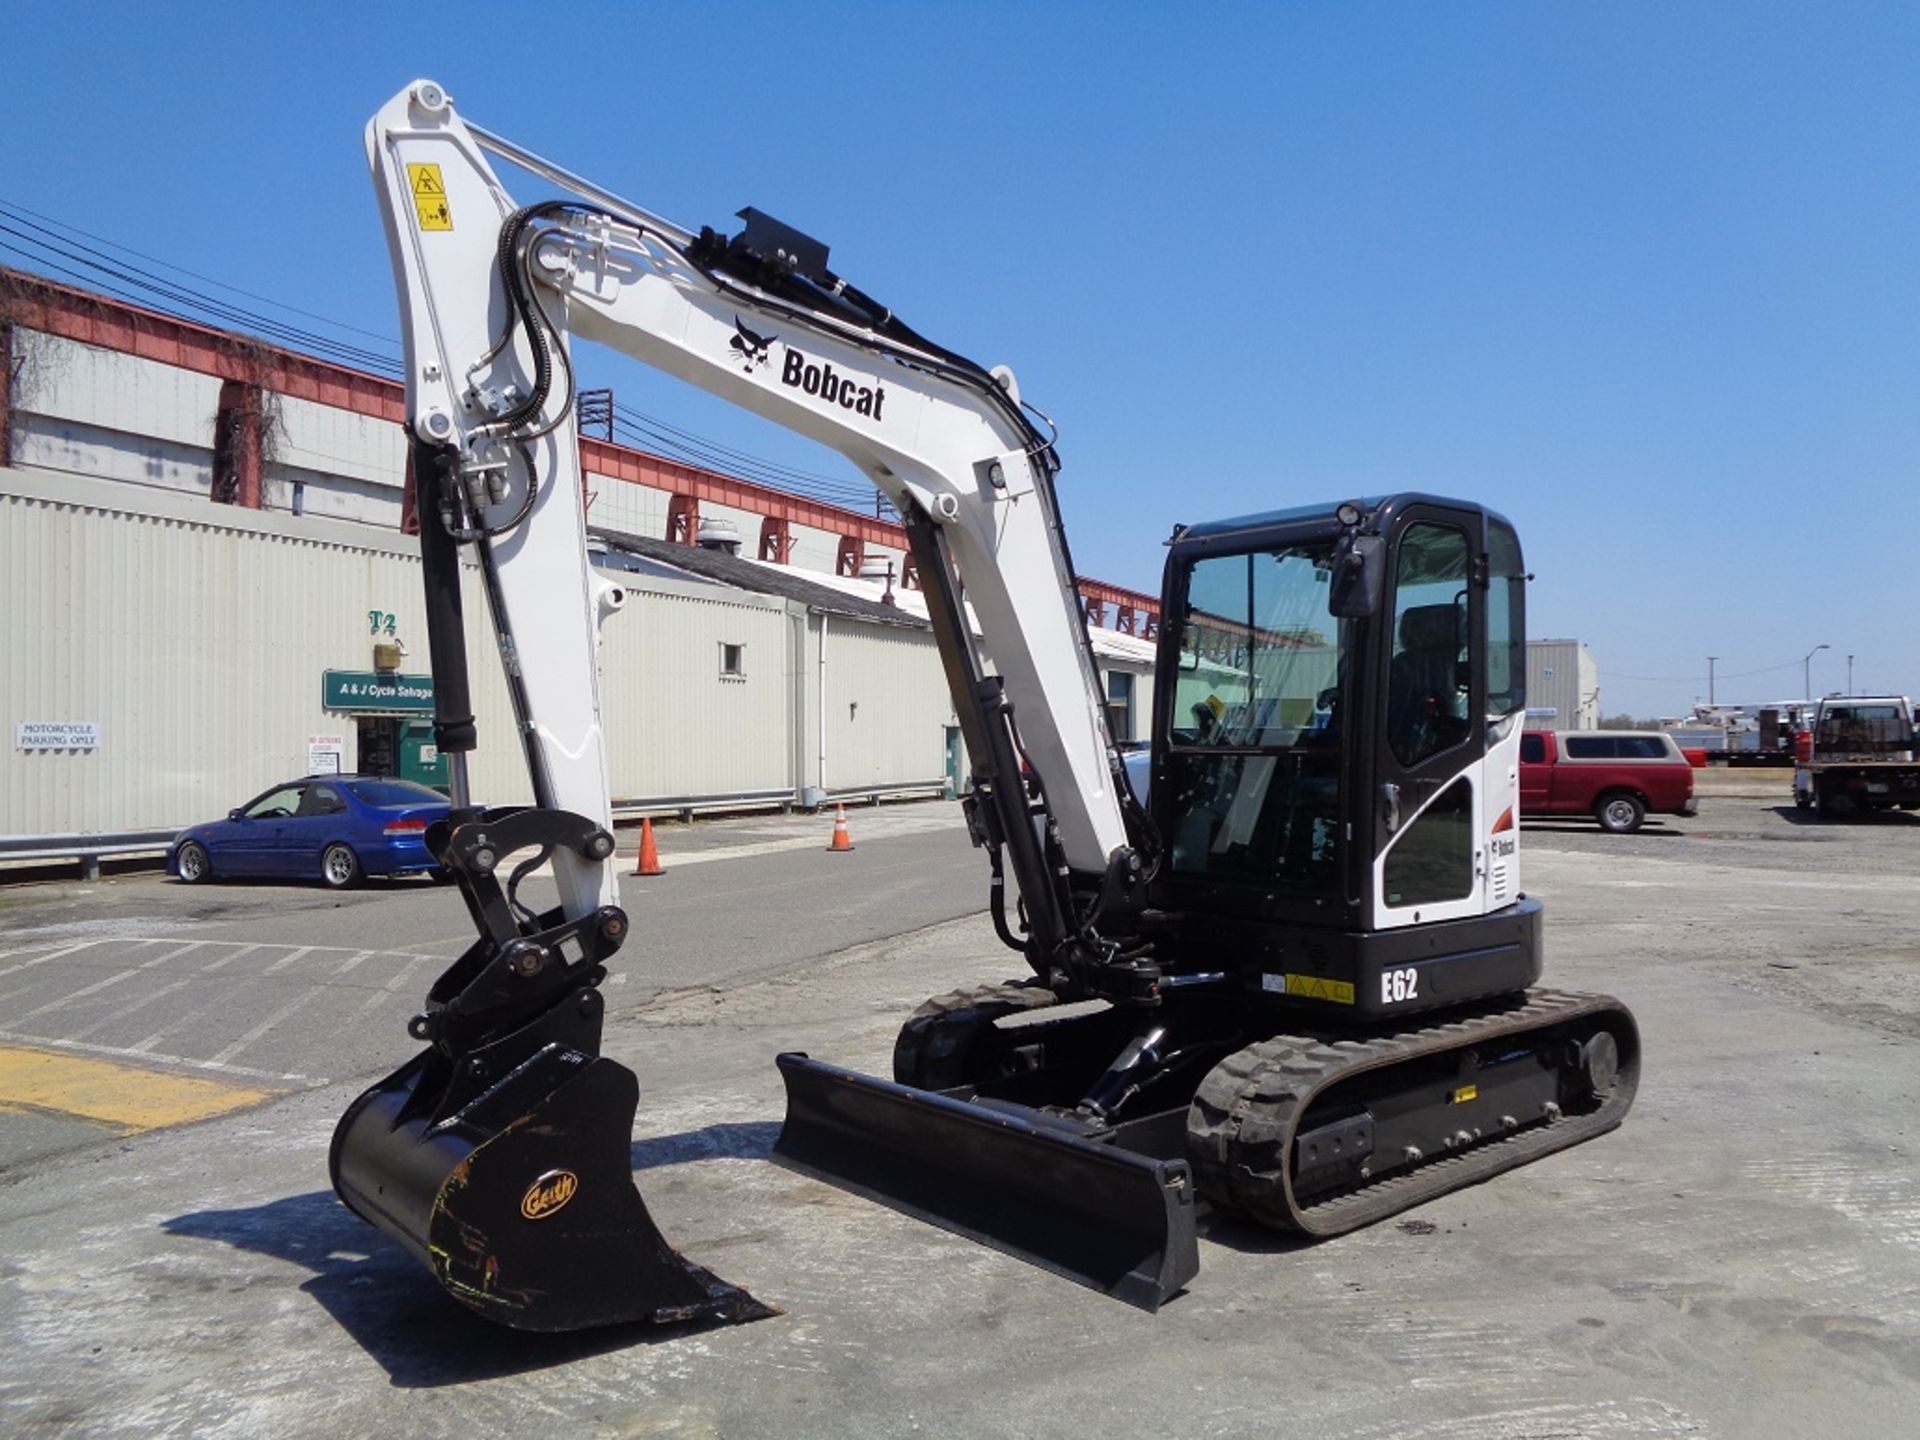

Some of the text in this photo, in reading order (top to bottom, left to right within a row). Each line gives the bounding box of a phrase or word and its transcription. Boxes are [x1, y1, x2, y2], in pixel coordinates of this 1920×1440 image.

[782, 348, 885, 422] Bobcat
[340, 683, 433, 700] A & J Cycle Salvage
[24, 724, 92, 734] MOTORCYCLE
[22, 735, 95, 745] PARKING ONLY
[1381, 968, 1418, 1004] E62
